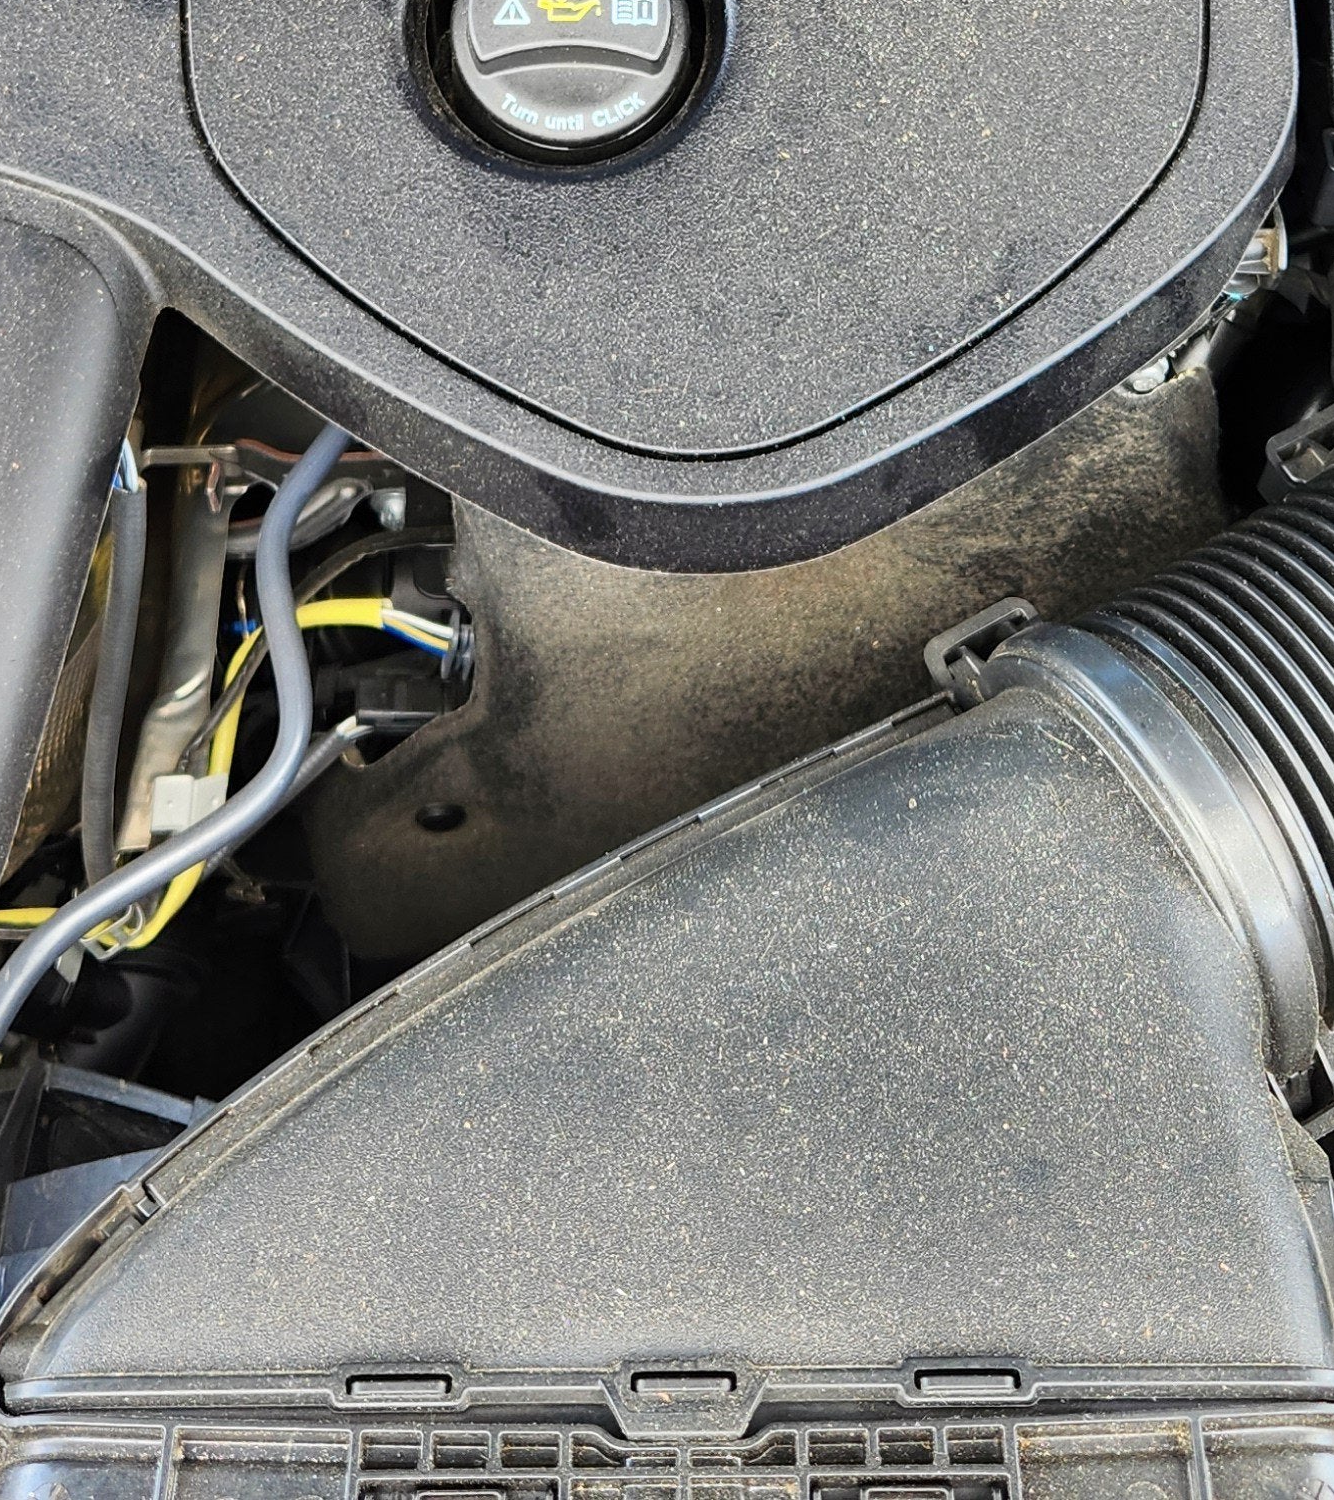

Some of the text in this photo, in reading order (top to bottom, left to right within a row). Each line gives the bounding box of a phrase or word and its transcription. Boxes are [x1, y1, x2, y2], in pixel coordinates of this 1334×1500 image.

[501, 92, 646, 131] Turn until CLICK
